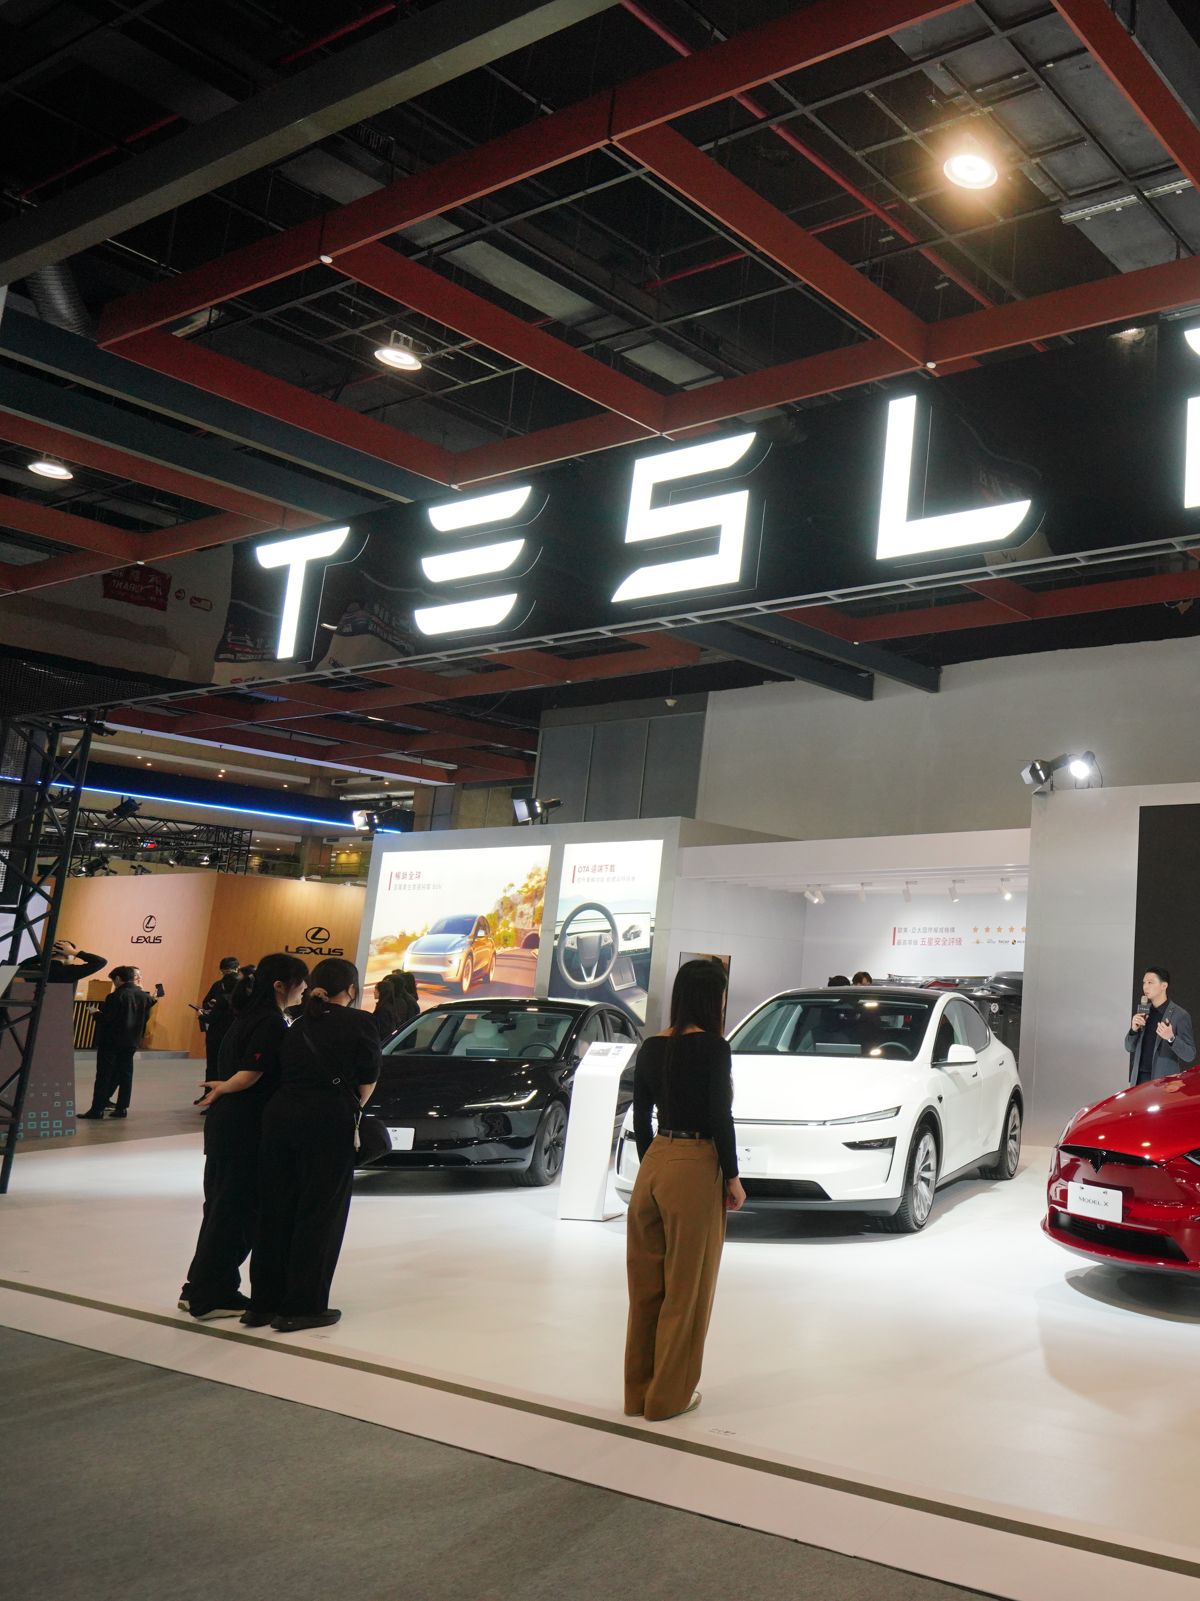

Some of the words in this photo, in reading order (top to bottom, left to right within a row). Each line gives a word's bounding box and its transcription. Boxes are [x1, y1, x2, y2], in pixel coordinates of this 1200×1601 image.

[577, 866, 590, 874] OTA
[130, 935, 163, 944] LEXUS
[285, 945, 344, 957] LEXUS
[1078, 1196, 1101, 1206] MODEL
